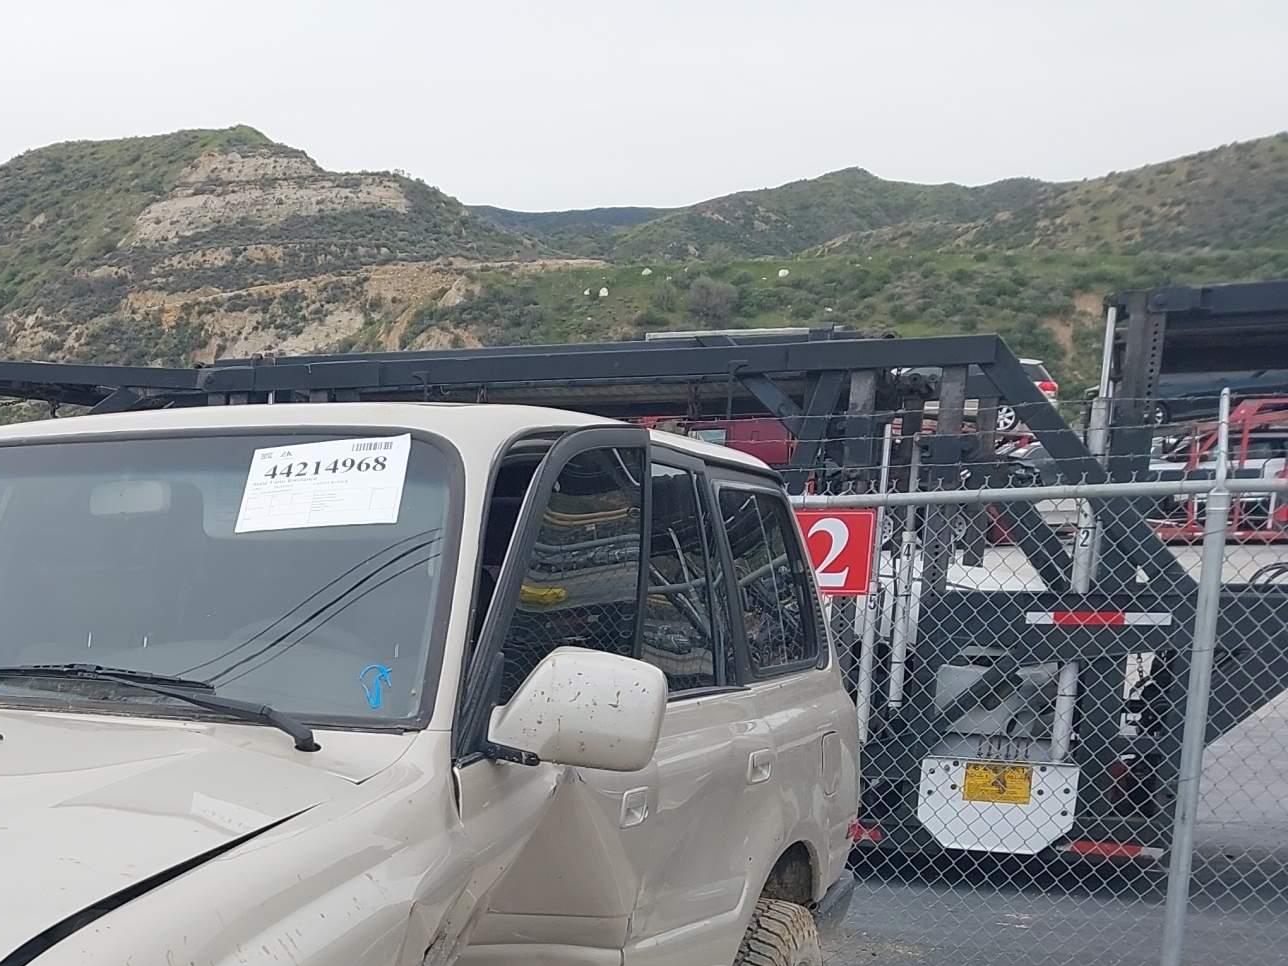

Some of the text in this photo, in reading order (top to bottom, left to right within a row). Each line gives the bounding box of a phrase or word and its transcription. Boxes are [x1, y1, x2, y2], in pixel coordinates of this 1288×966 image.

[264, 455, 388, 479] 44214968
[1079, 529, 1090, 548] 2
[807, 517, 849, 587] 2
[903, 543, 912, 561] 4
